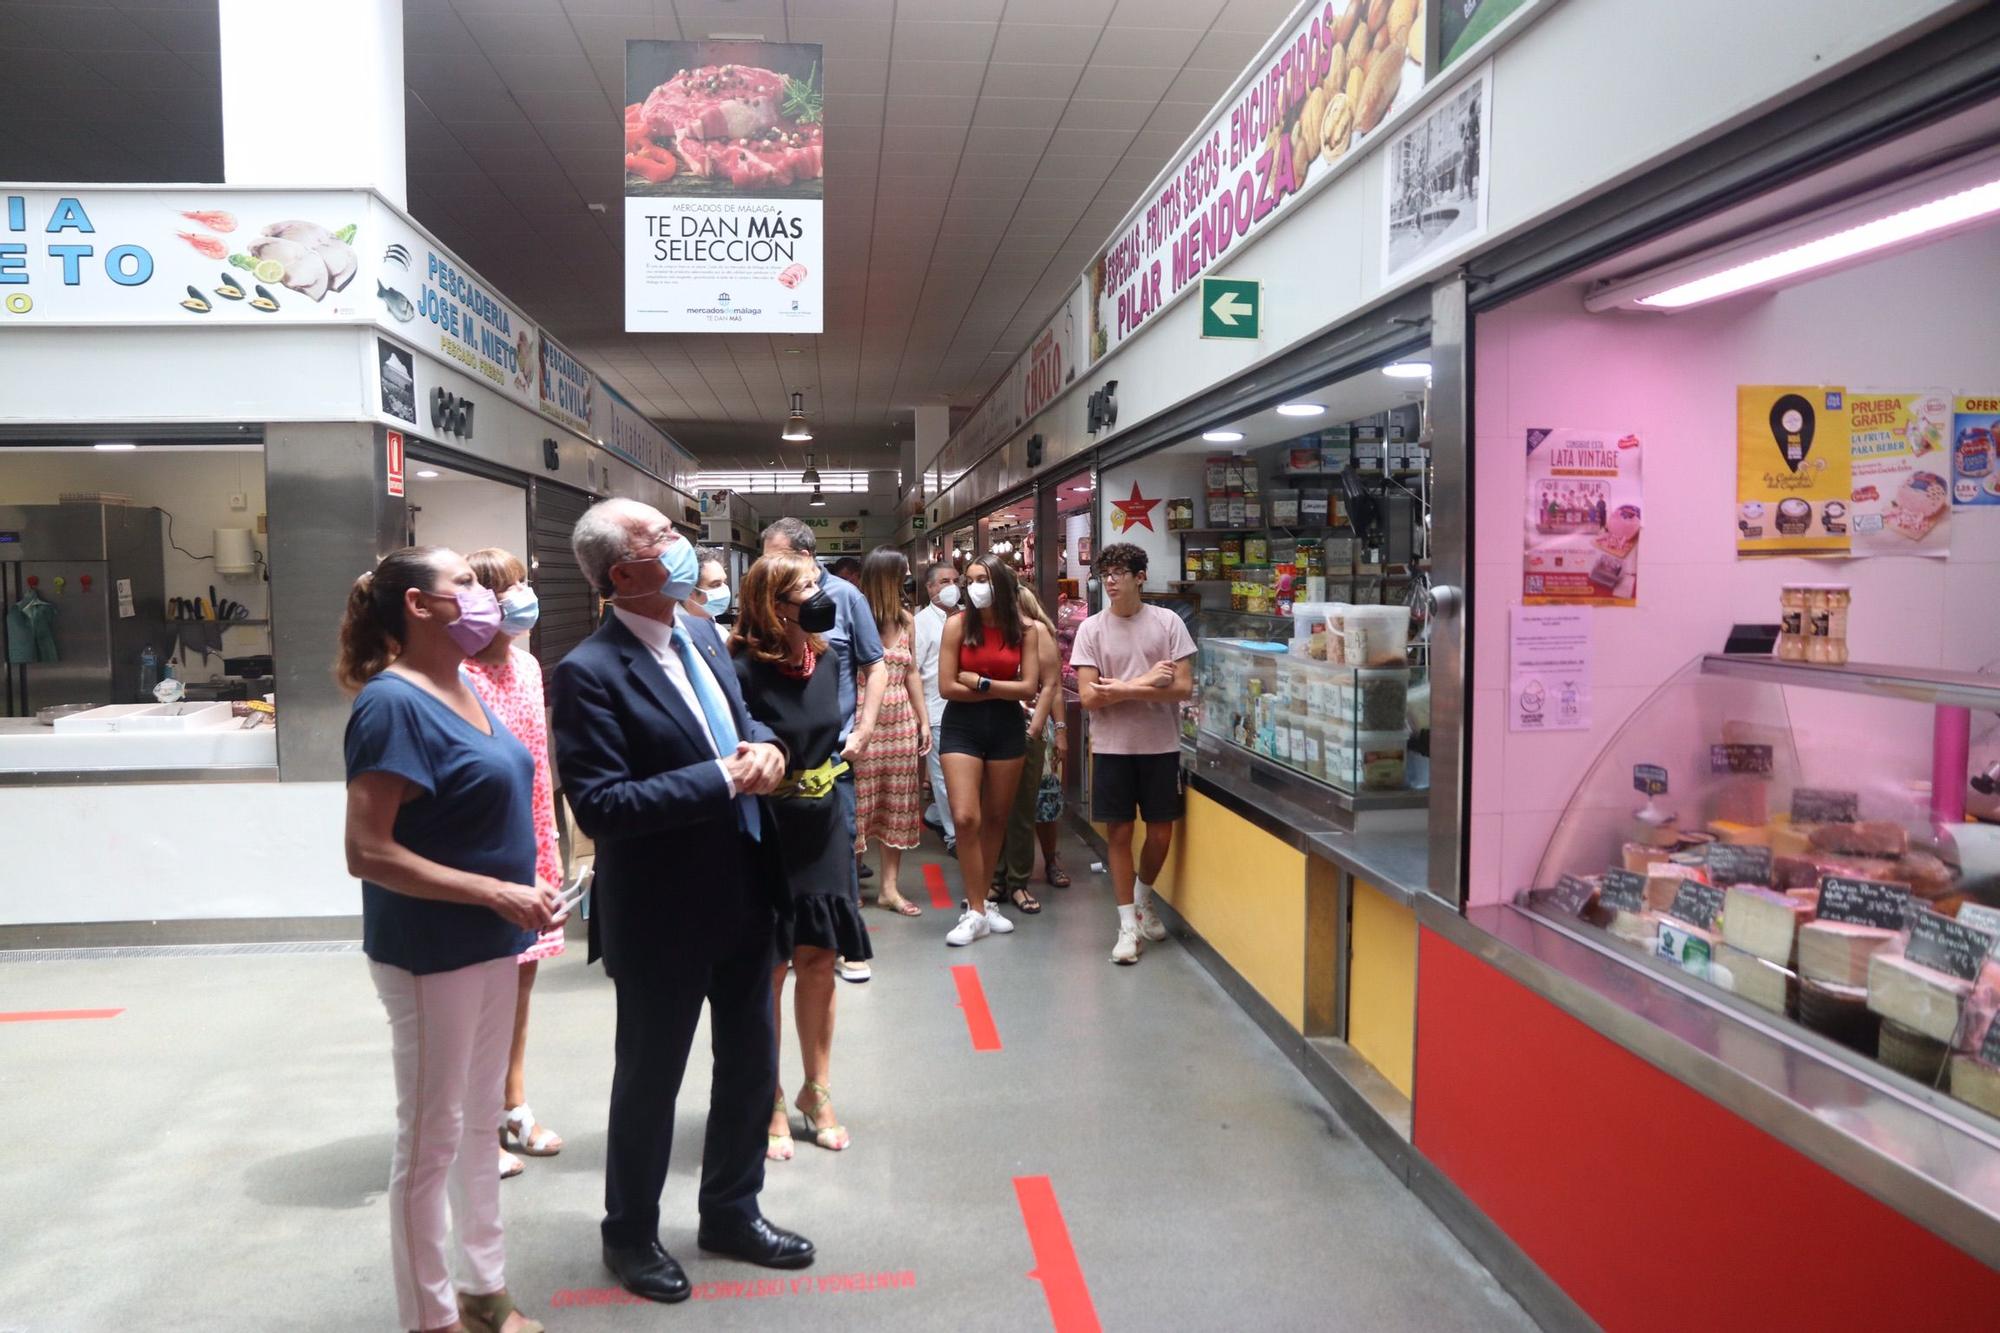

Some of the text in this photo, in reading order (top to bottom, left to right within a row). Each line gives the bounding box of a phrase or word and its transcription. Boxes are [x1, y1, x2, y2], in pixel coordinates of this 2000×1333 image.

[1107, 2, 1334, 298] ESPECIAS FRUTOS SECOS ENCURTIDOS
[673, 204, 722, 213] MERCADOS
[725, 205, 736, 213] DE
[645, 211, 803, 239] TE DAN MÁS
[1117, 133, 1298, 340] PILAR MENDOZA
[654, 239, 794, 262] SELECCIÓN
[428, 250, 512, 338] PESCADERIA
[418, 284, 459, 338] JOSE
[481, 325, 518, 374] NIETO
[1851, 399, 1901, 415] PRUEBA
[1966, 400, 2000, 411] OFER
[1851, 412, 1896, 428] GRATIS
[1851, 432, 1891, 444] LA FRUTA
[1851, 441, 1905, 455] PARA BEBER
[1550, 449, 1619, 469] LATA VINTAGE
[818, 1271, 916, 1295] MANTENGA
